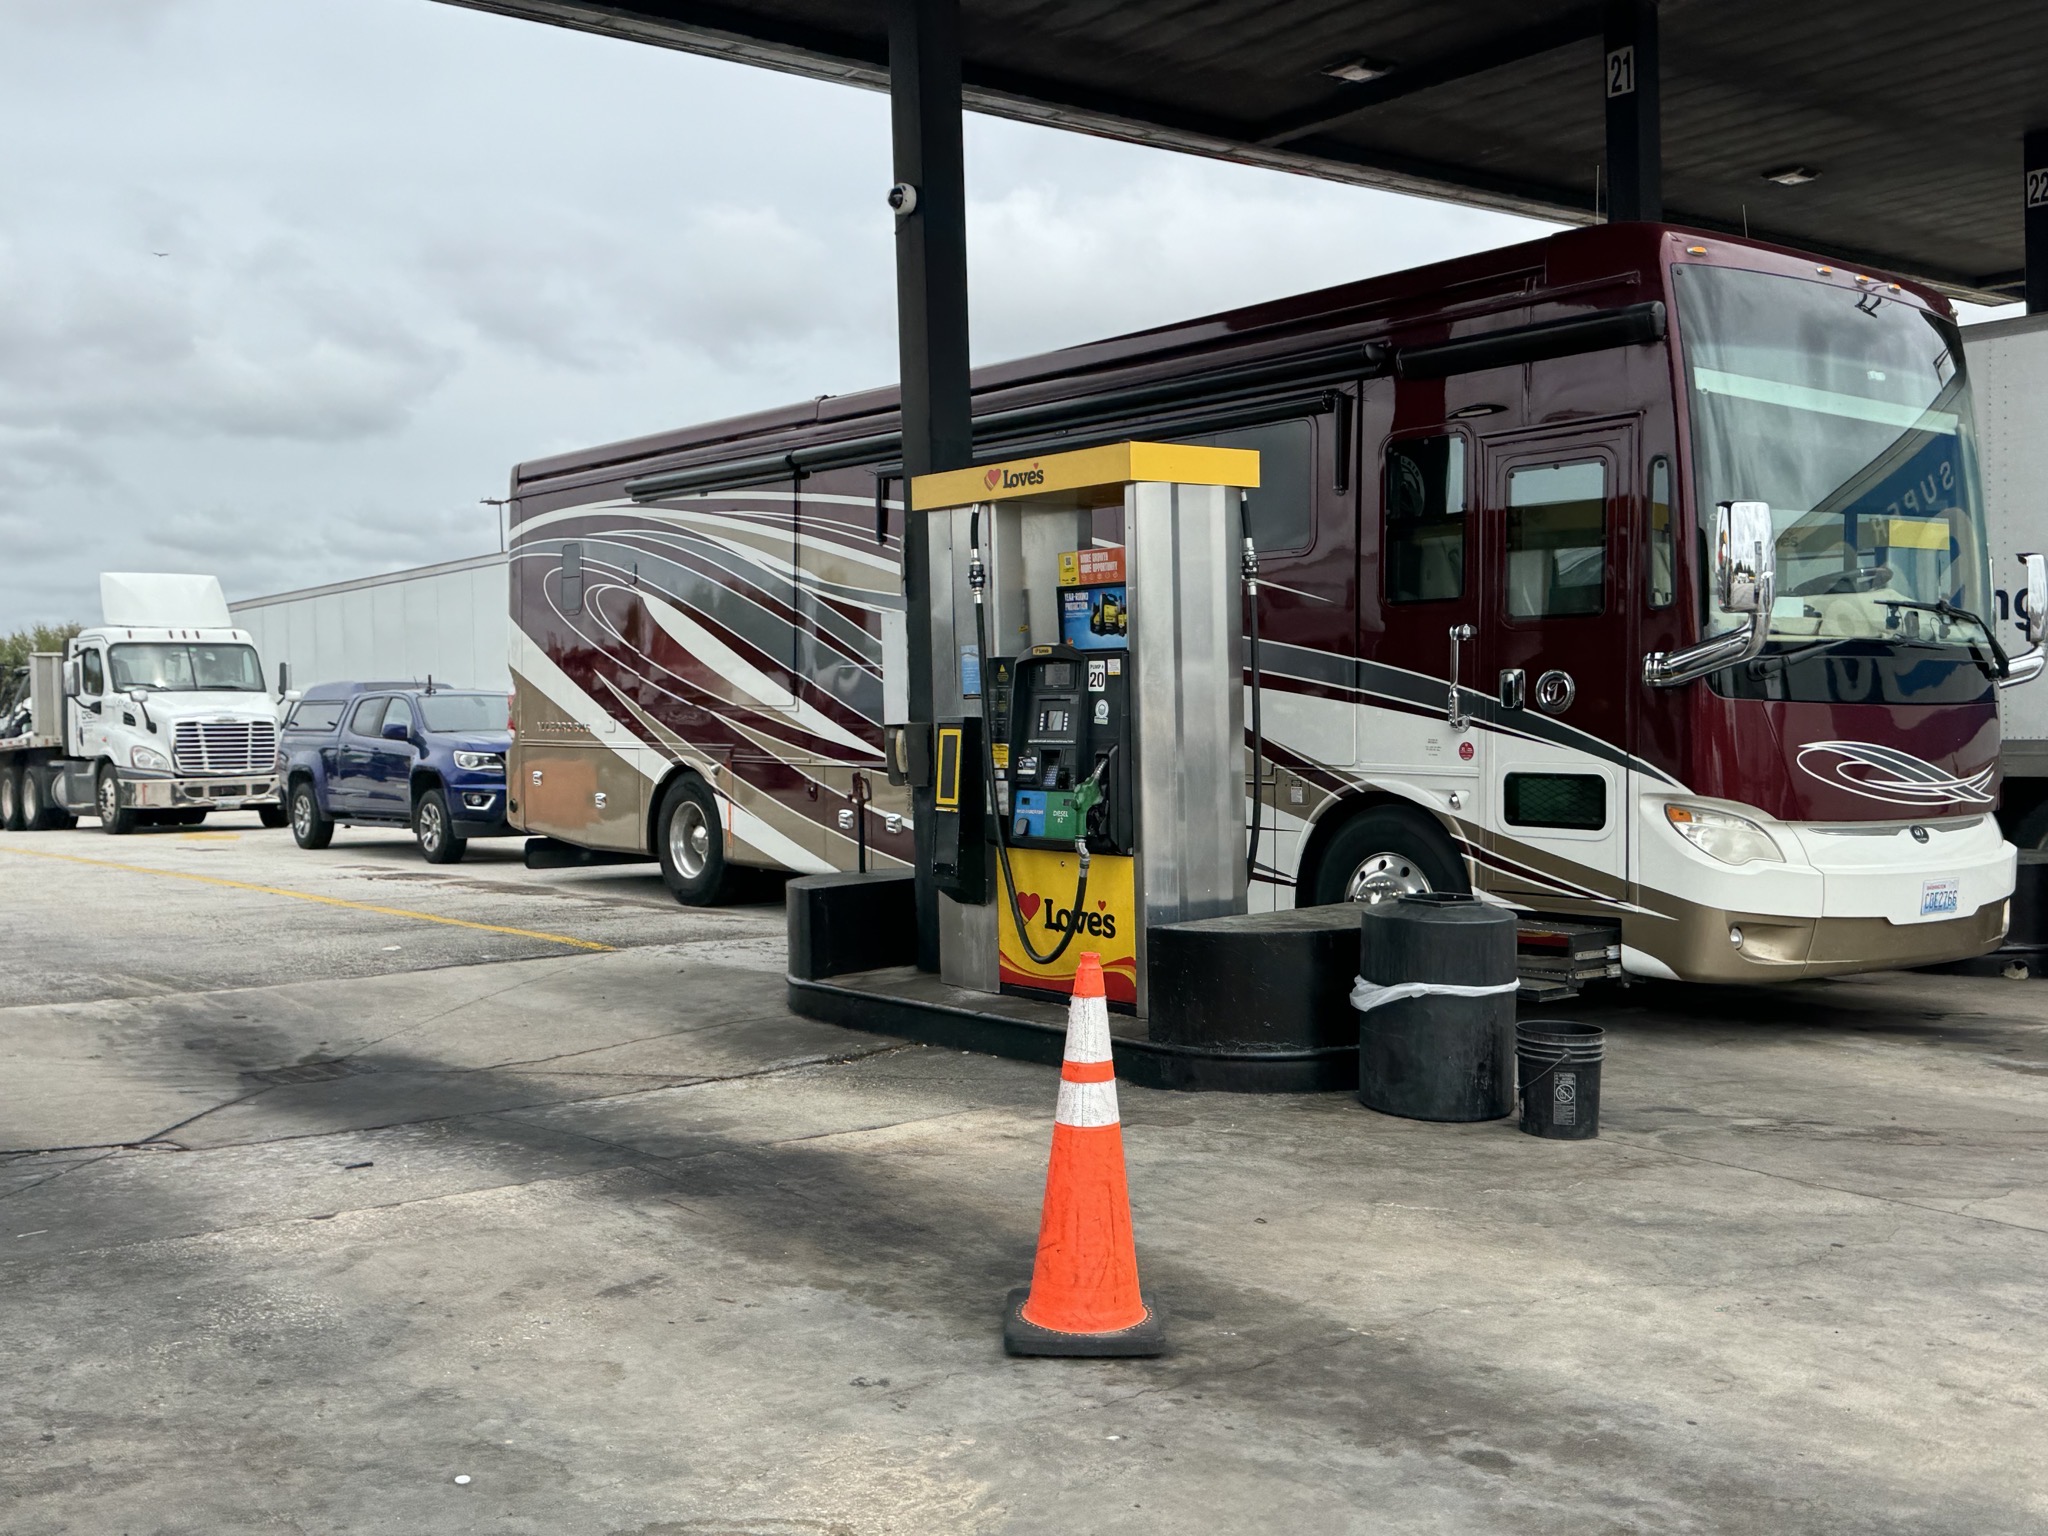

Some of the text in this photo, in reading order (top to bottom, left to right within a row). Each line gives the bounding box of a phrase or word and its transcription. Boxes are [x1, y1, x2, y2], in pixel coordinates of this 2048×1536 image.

[1611, 51, 1631, 93] 21
[2030, 171, 2048, 204] 22
[1090, 672, 1104, 687] 20
